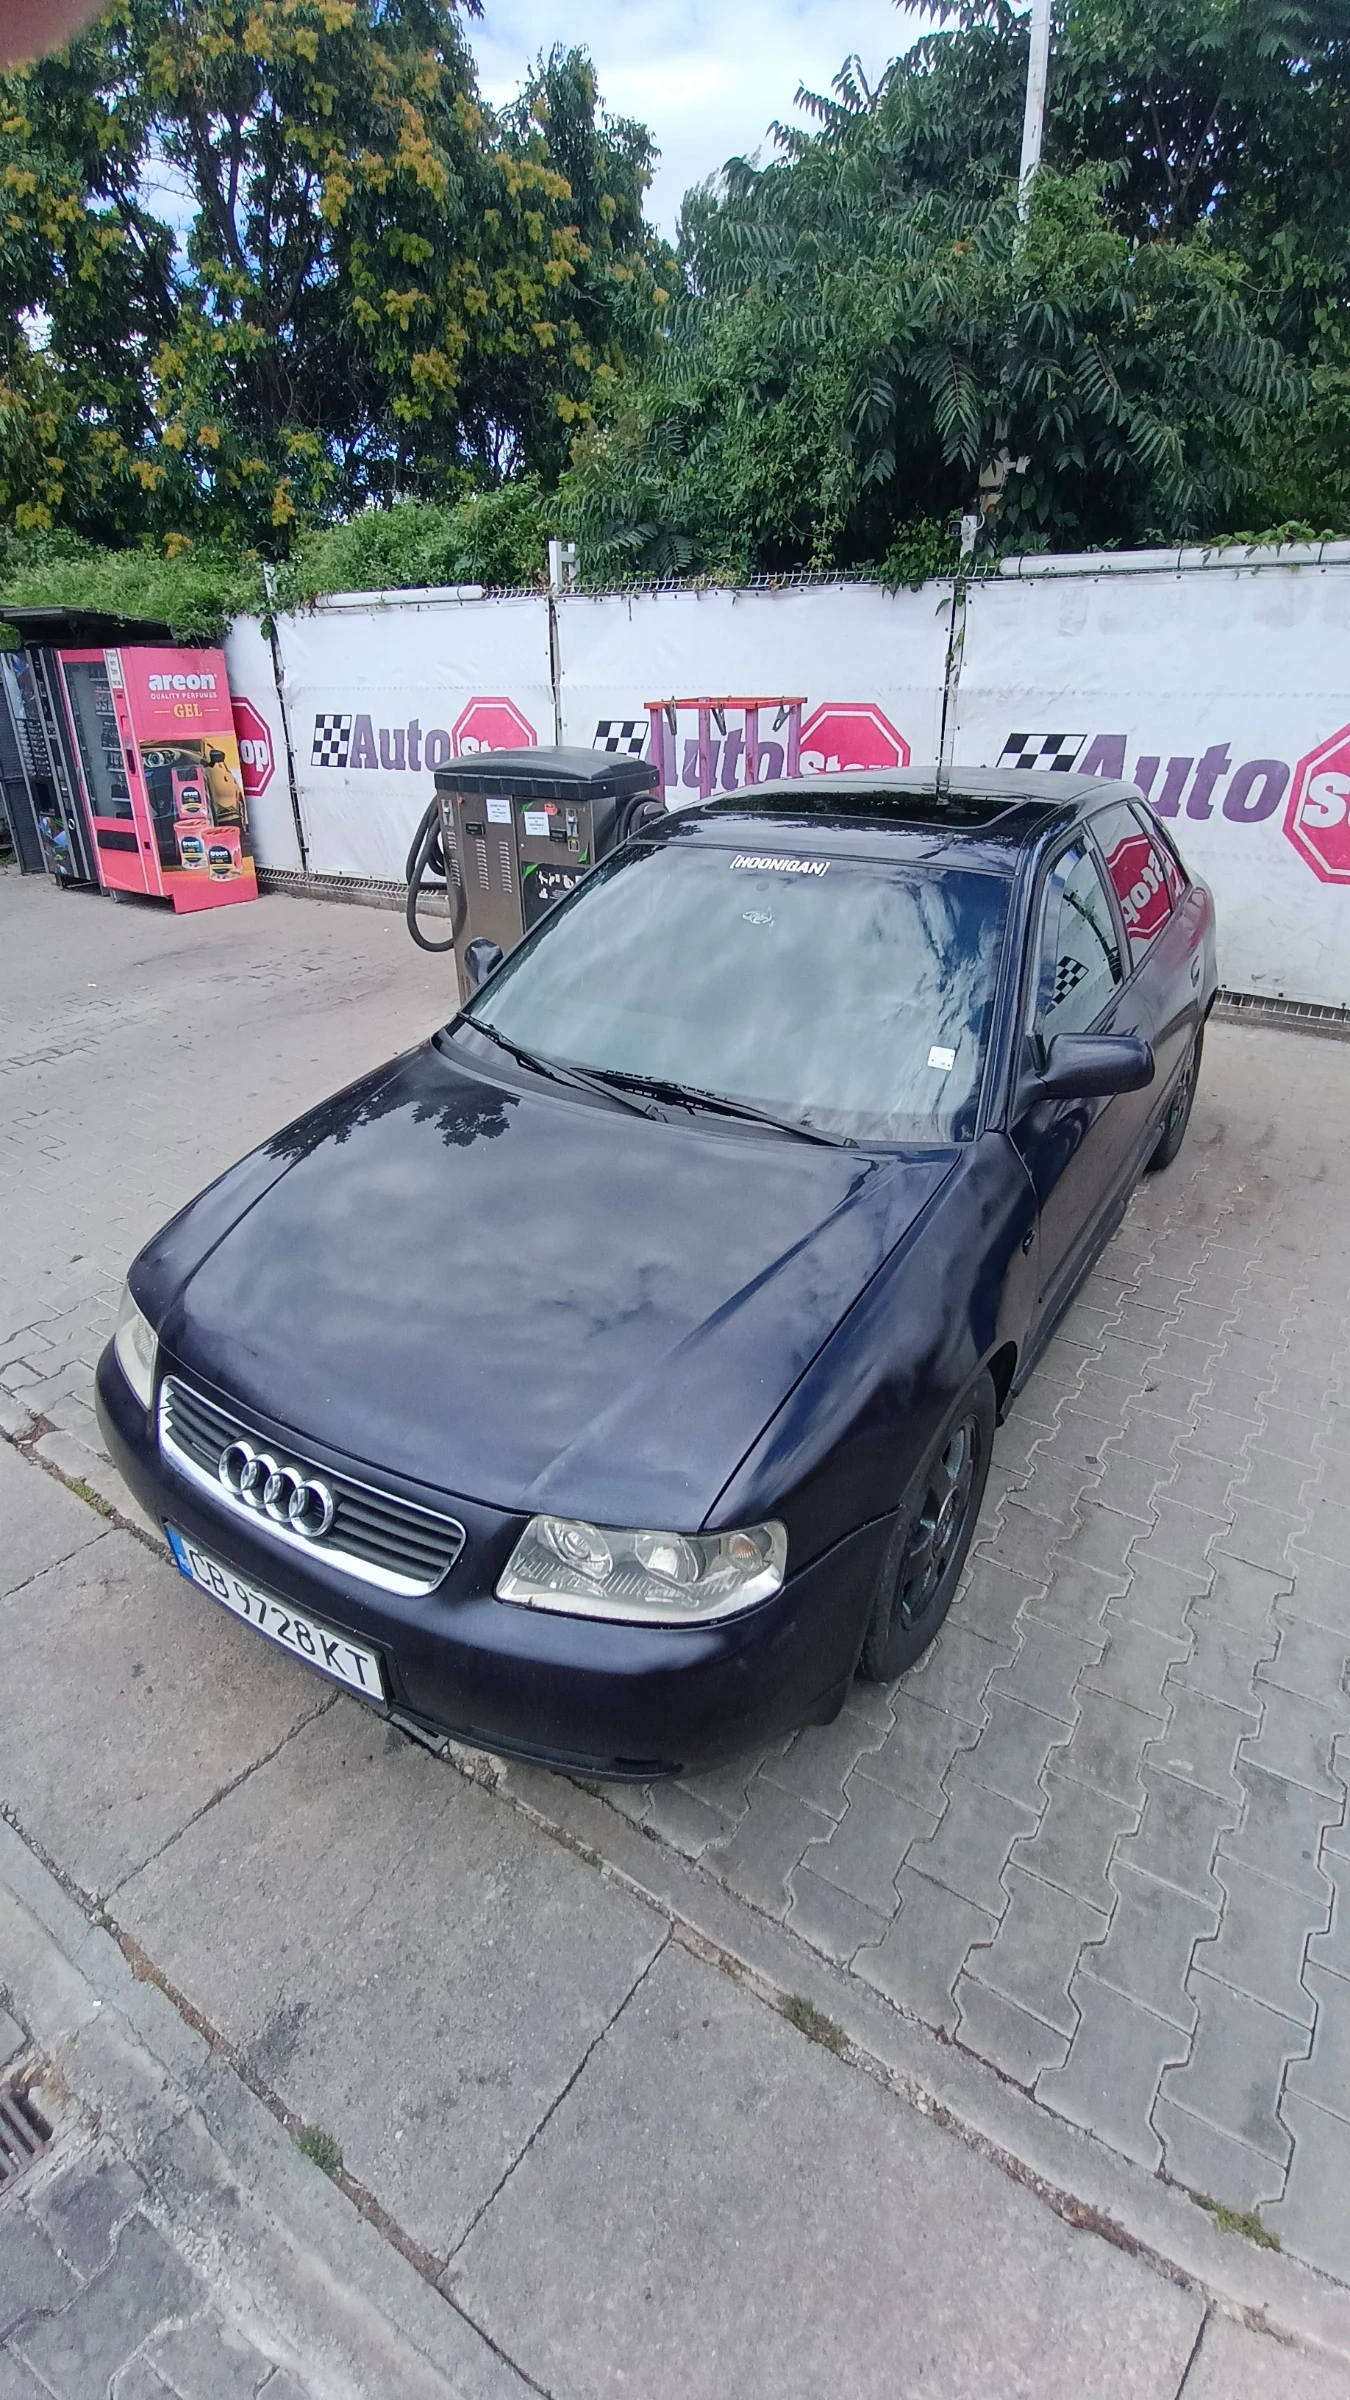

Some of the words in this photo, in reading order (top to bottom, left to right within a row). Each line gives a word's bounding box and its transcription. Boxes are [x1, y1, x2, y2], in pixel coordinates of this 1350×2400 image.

[149, 674, 216, 691] areon
[150, 692, 180, 700] QUALITY
[182, 691, 217, 699] PERFUMES
[173, 703, 203, 718] GEL
[239, 739, 270, 773] op
[350, 714, 450, 772] Auto
[1077, 734, 1291, 824] Auto
[188, 1549, 230, 1600] CB
[232, 1581, 316, 1656] 9728
[318, 1633, 369, 1687] KT
